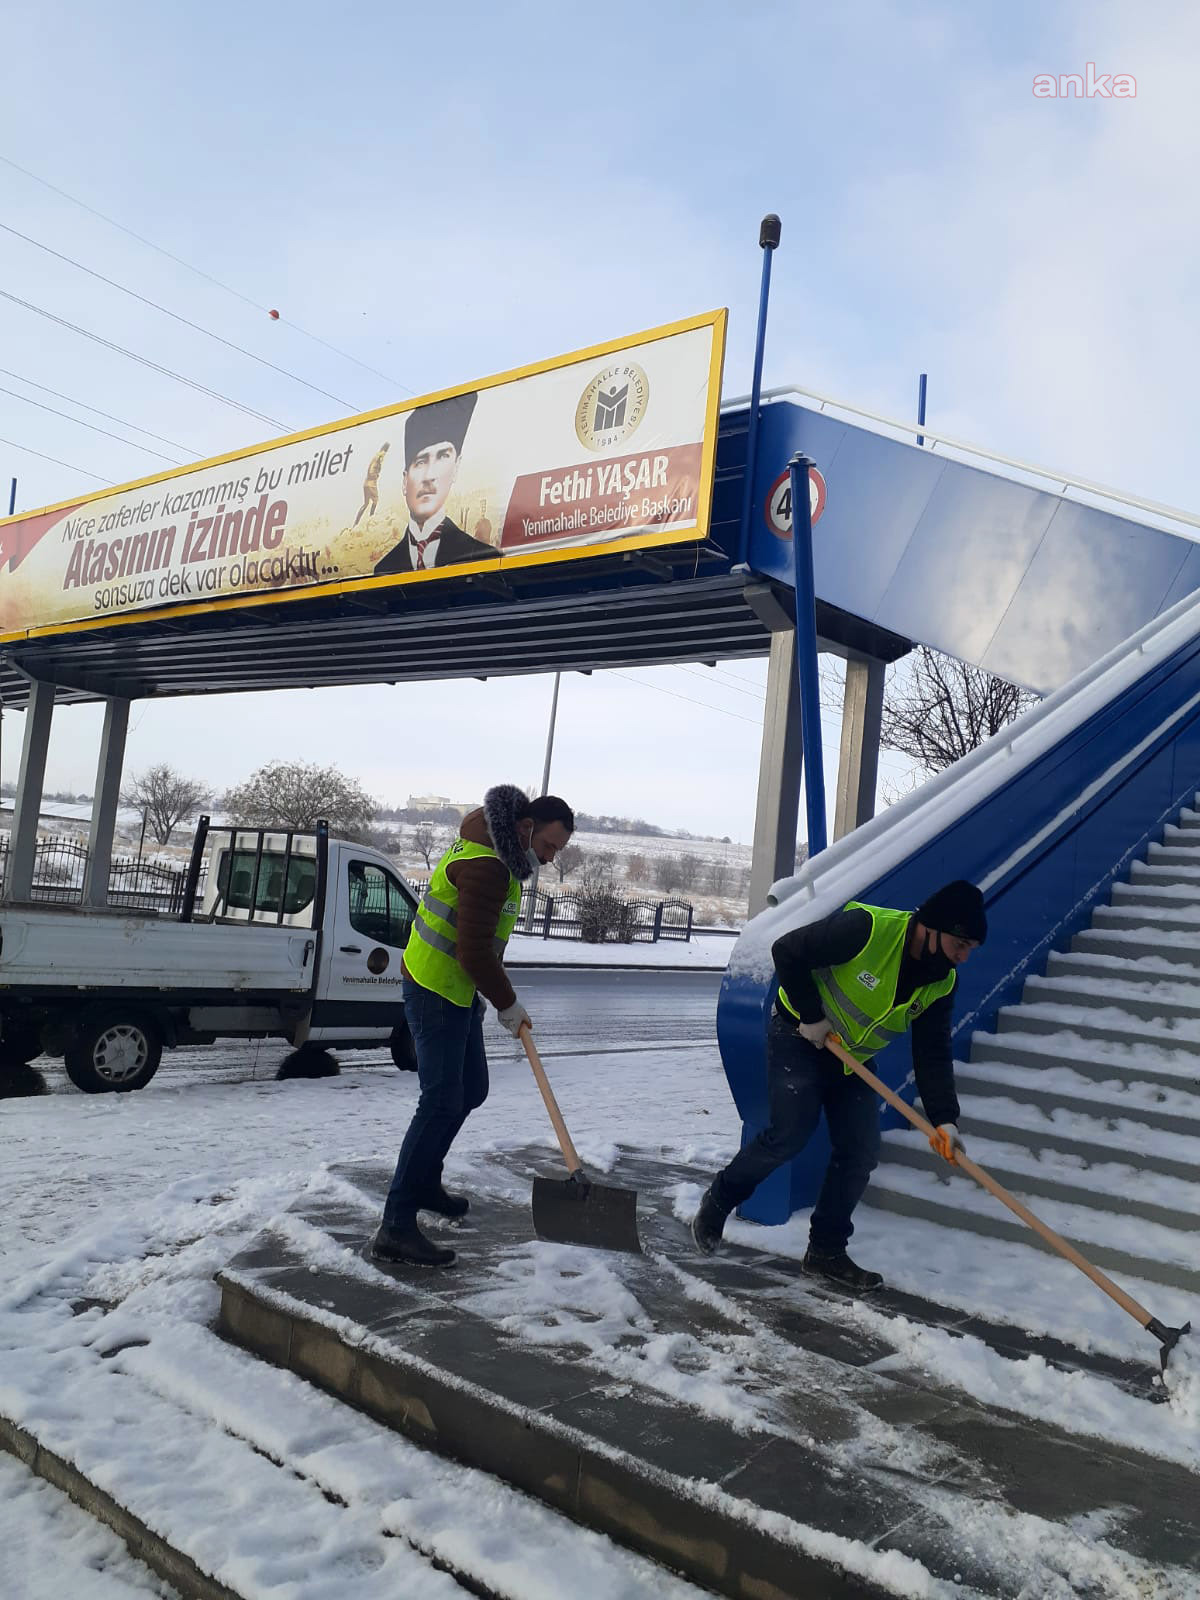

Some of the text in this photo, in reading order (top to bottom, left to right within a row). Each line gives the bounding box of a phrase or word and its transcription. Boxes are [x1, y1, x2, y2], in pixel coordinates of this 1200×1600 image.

[62, 443, 353, 542] Nice zaferler kazanmış bu millet
[539, 455, 669, 507] Fethi YAŞAR
[63, 493, 288, 591] Atasının izinde
[522, 496, 692, 537] Yenimahalle Belediye Başkanı
[94, 546, 339, 611] sonsuza dek var olacaktır...
